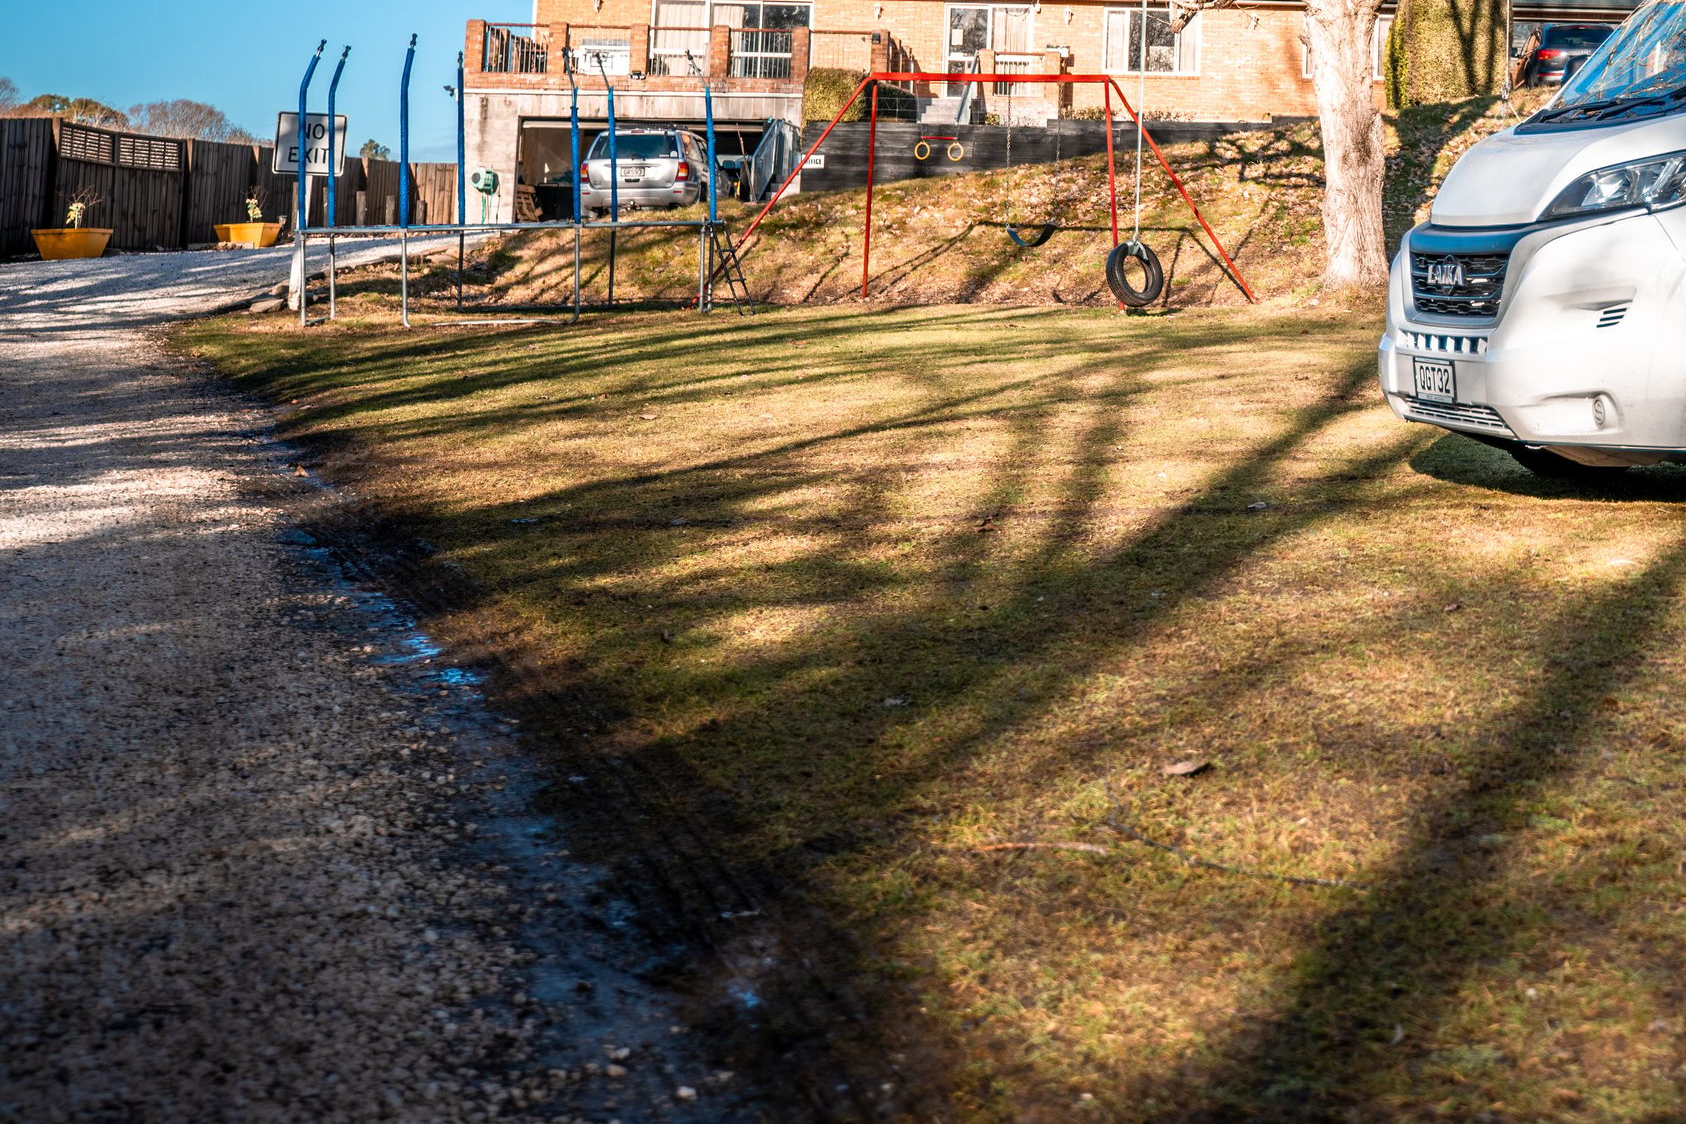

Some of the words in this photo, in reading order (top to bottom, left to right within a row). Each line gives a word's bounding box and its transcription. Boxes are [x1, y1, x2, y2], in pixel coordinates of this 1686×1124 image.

[287, 147, 331, 164] EXIT
[1427, 264, 1465, 286] LAIKA
[1420, 365, 1451, 394] QGT32
